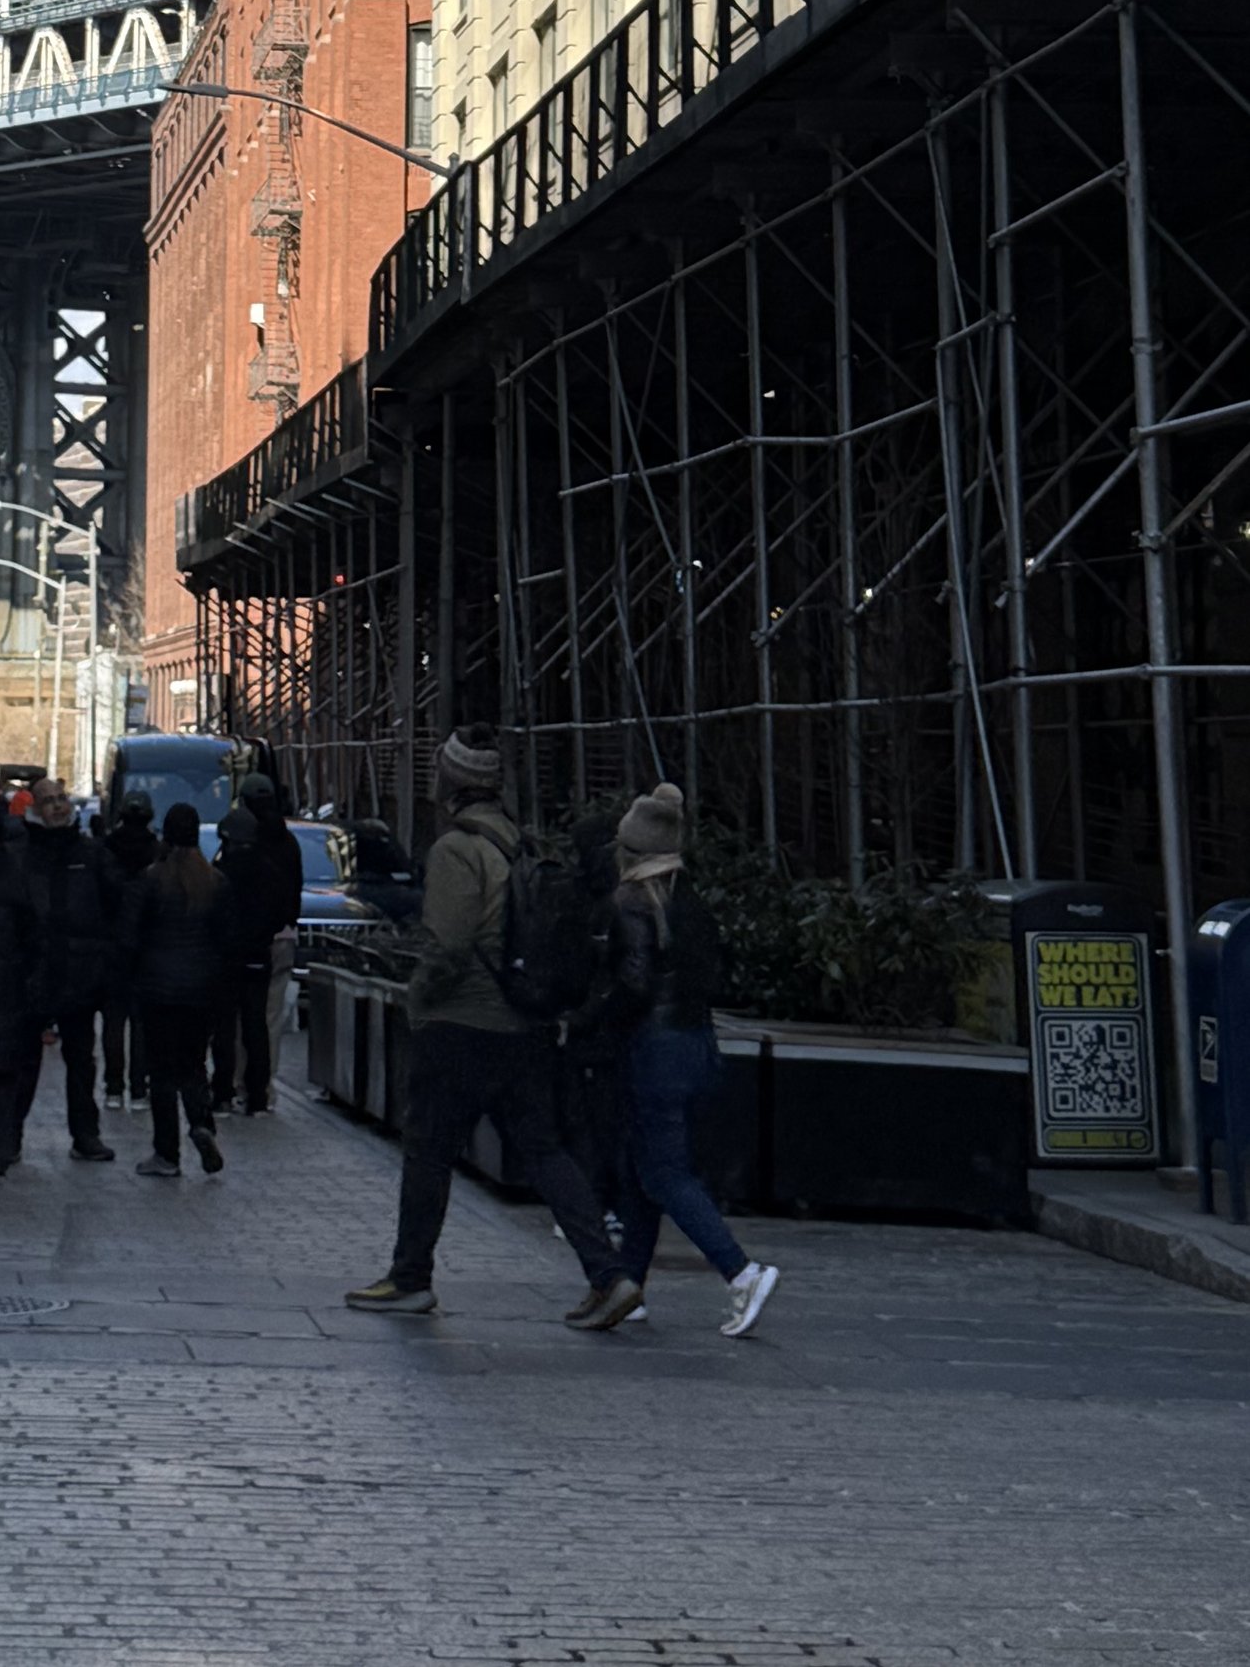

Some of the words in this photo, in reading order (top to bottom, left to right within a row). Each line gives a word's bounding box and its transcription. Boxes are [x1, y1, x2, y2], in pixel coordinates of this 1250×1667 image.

[1037, 941, 1135, 963] WHERE
[1037, 963, 1137, 985] SHOULD
[1039, 985, 1077, 1007] WE
[1081, 985, 1138, 1007] EAT?
